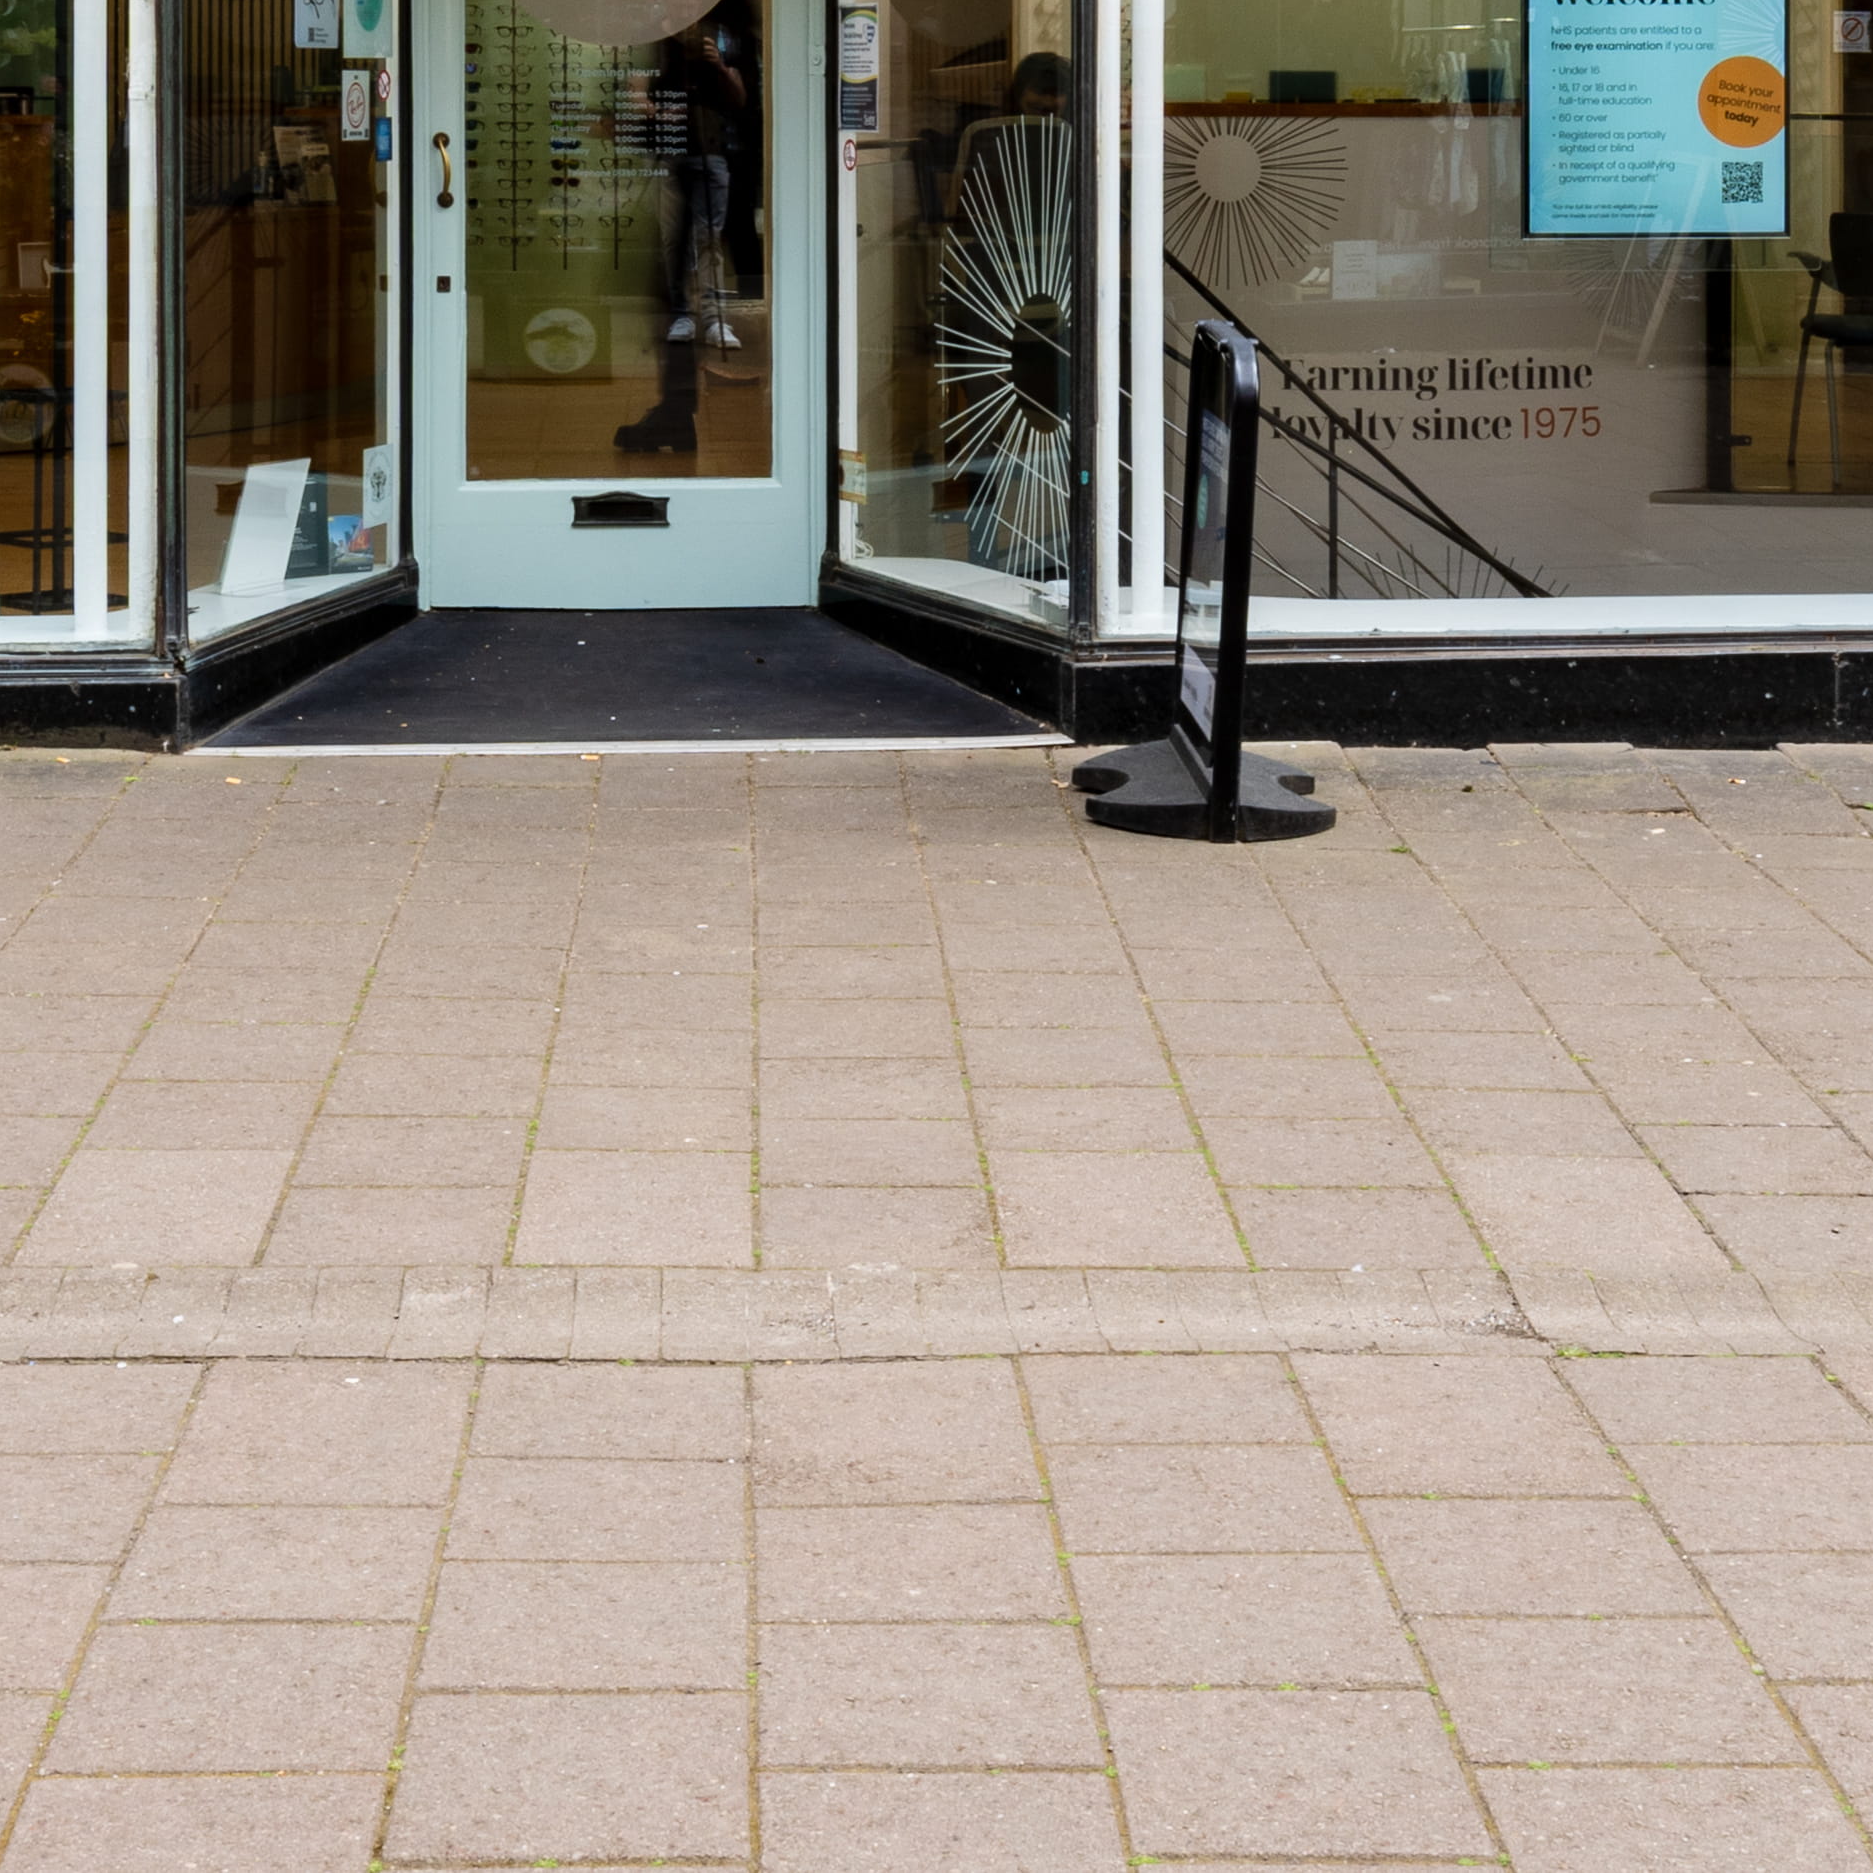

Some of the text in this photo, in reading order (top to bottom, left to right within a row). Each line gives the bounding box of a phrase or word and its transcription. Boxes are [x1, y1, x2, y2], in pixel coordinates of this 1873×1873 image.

[1551, 26, 1572, 35] NHS
[1575, 26, 1617, 36] patients
[1640, 26, 1678, 35] entitled
[1681, 27, 1692, 35] to
[1551, 41, 1572, 50] free
[1574, 43, 1593, 53] eye
[1596, 41, 1663, 50] examination
[1665, 41, 1671, 50] if
[1674, 43, 1693, 53] you
[1559, 66, 1588, 75] Under
[1606, 83, 1626, 91] and
[1628, 83, 1637, 91] in
[1719, 79, 1774, 98] Book your
[1559, 96, 1652, 105] full-time education
[1707, 94, 1781, 114] appointment
[1559, 113, 1571, 122] 60
[1725, 110, 1758, 127] today
[1559, 131, 1611, 141] Registered
[1627, 130, 1666, 141] partially
[1559, 144, 1595, 154] sighted
[1610, 143, 1634, 152] blind
[1559, 161, 1567, 169] In
[1570, 161, 1604, 171] receipt
[1606, 161, 1616, 169] of
[1627, 161, 1675, 171] qualifying
[1559, 175, 1619, 185] government
[1282, 356, 1593, 401] Earning lifetime
[1270, 407, 1403, 450] loyalty
[1412, 407, 1512, 441] since
[1520, 406, 1601, 439] 1975
